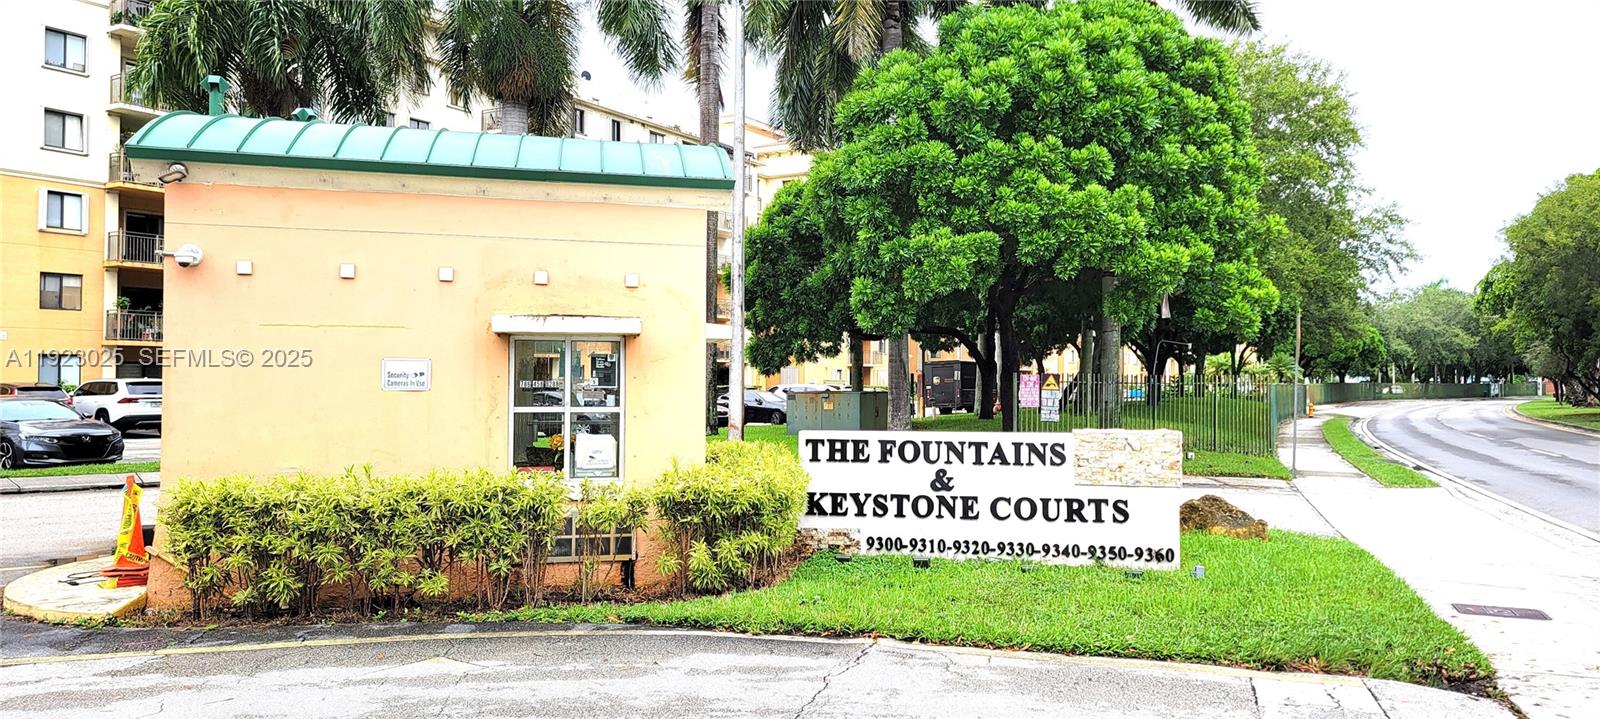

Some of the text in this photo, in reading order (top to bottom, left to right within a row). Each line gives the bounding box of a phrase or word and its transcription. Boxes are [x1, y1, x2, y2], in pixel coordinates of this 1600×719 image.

[387, 371, 410, 379] Security
[387, 379, 409, 387] Cameras
[805, 438, 1067, 468] THE FOUNTAINS
[930, 468, 955, 493] &
[804, 491, 1130, 525] KEYSTONE COURTS
[865, 535, 1176, 564] 9300-9310-9320-9330-9340-9350-9360
